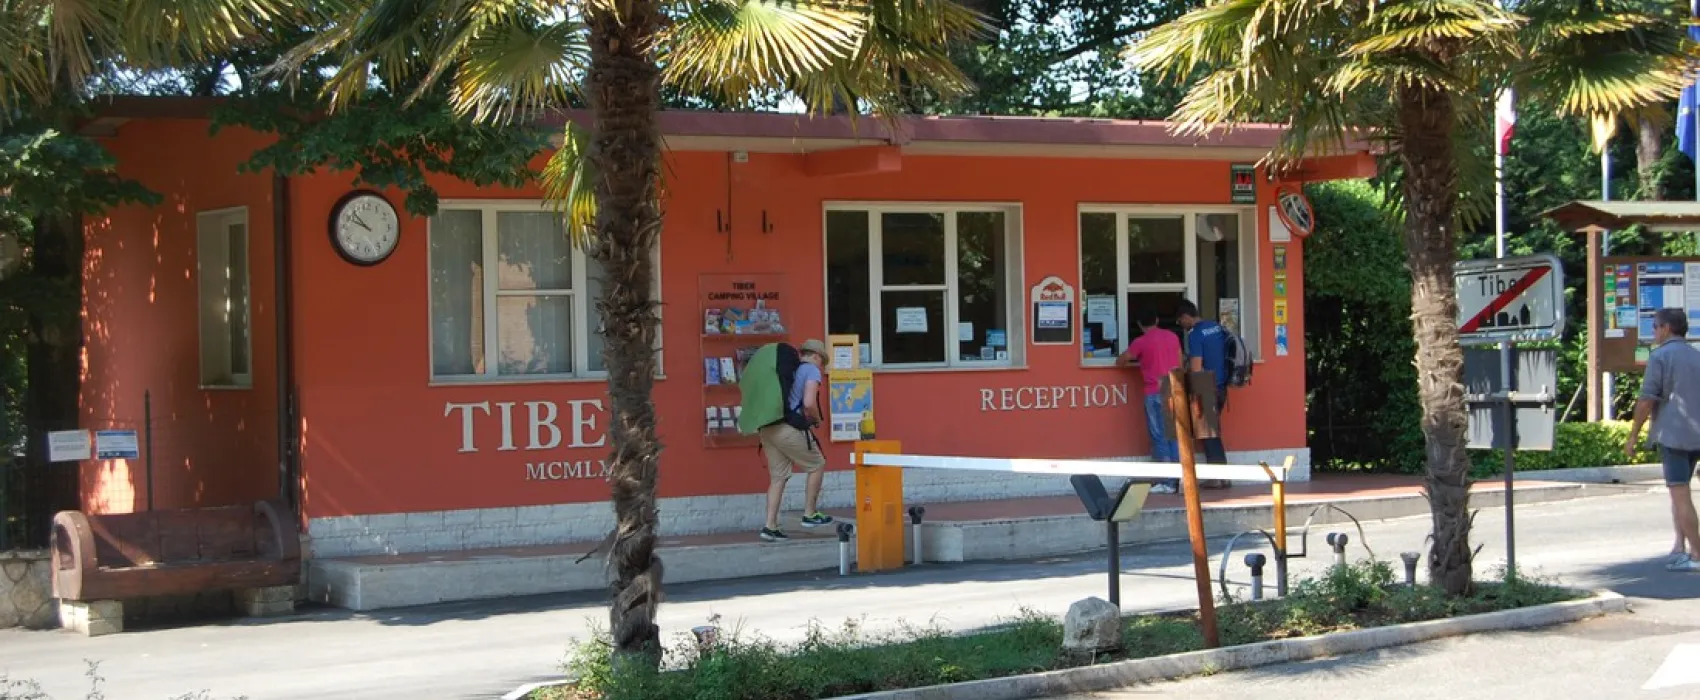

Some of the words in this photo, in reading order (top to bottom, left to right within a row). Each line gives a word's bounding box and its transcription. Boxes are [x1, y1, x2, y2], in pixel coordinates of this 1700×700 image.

[708, 292, 744, 300] CAMPING
[746, 291, 779, 300] VILLAGE
[979, 383, 1128, 411] RECEPTION
[444, 399, 606, 452] TIBE
